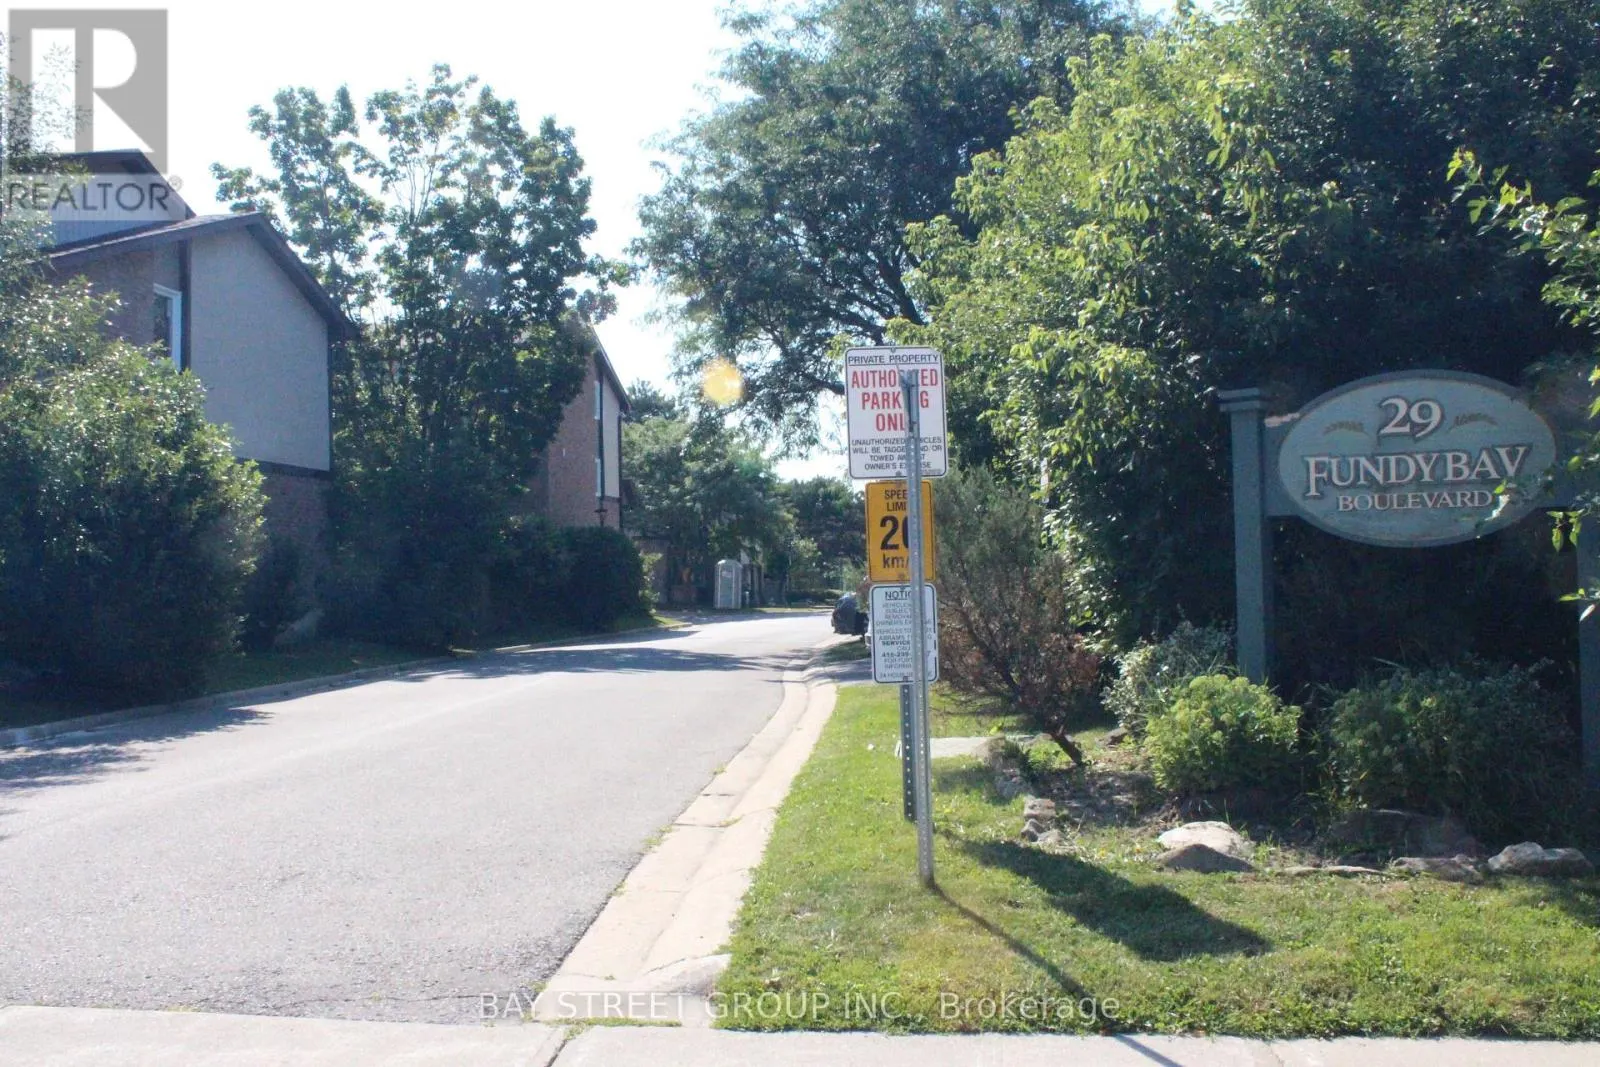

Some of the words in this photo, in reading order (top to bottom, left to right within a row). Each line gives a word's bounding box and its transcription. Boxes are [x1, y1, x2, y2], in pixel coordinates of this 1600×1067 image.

[848, 355, 885, 364] PRIVATE
[889, 354, 939, 363] PROPERTY
[851, 368, 939, 389] AUTHOED
[861, 390, 930, 410] PARKG
[875, 413, 908, 432] ONL
[1378, 397, 1444, 438] 29
[852, 437, 906, 446] UNAUTHORIZED
[852, 446, 868, 454] WILL
[871, 445, 881, 453] BE
[884, 444, 907, 453] TAGGE
[864, 463, 897, 471] OWNER'S
[1303, 452, 1440, 498] FUNDY
[884, 489, 908, 500] SPEE
[1337, 490, 1494, 512] BOULEVARD
[886, 501, 907, 512] LIMI
